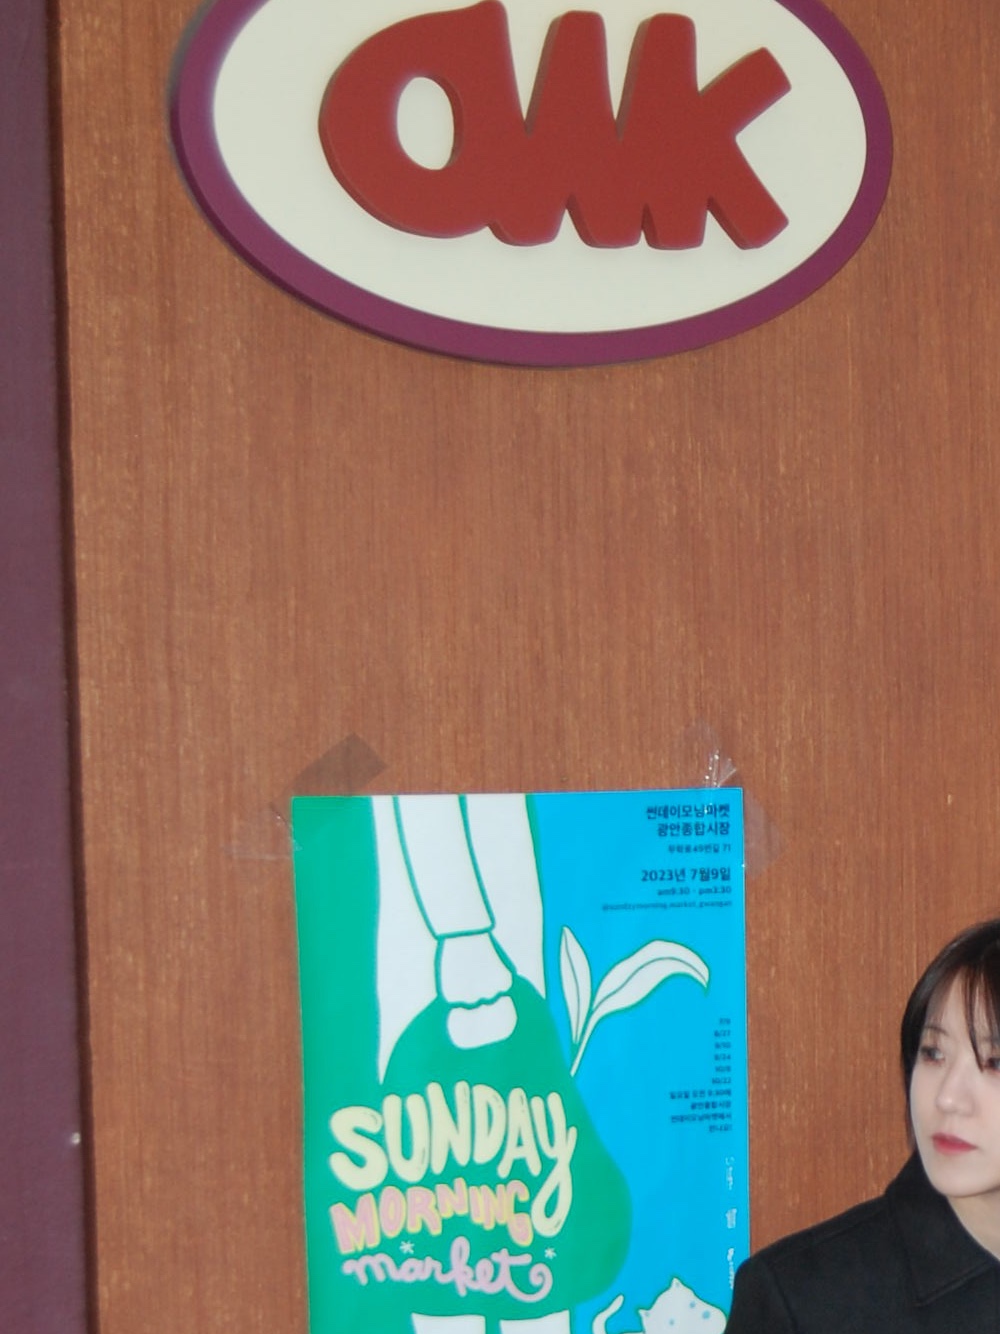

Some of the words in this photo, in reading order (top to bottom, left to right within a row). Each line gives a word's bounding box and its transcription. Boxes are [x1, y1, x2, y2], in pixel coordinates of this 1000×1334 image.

[641, 868, 686, 883] 2023년
[329, 1079, 577, 1238] SUNDAY
[329, 1176, 534, 1255] MORNING
[341, 1236, 553, 1303] market
